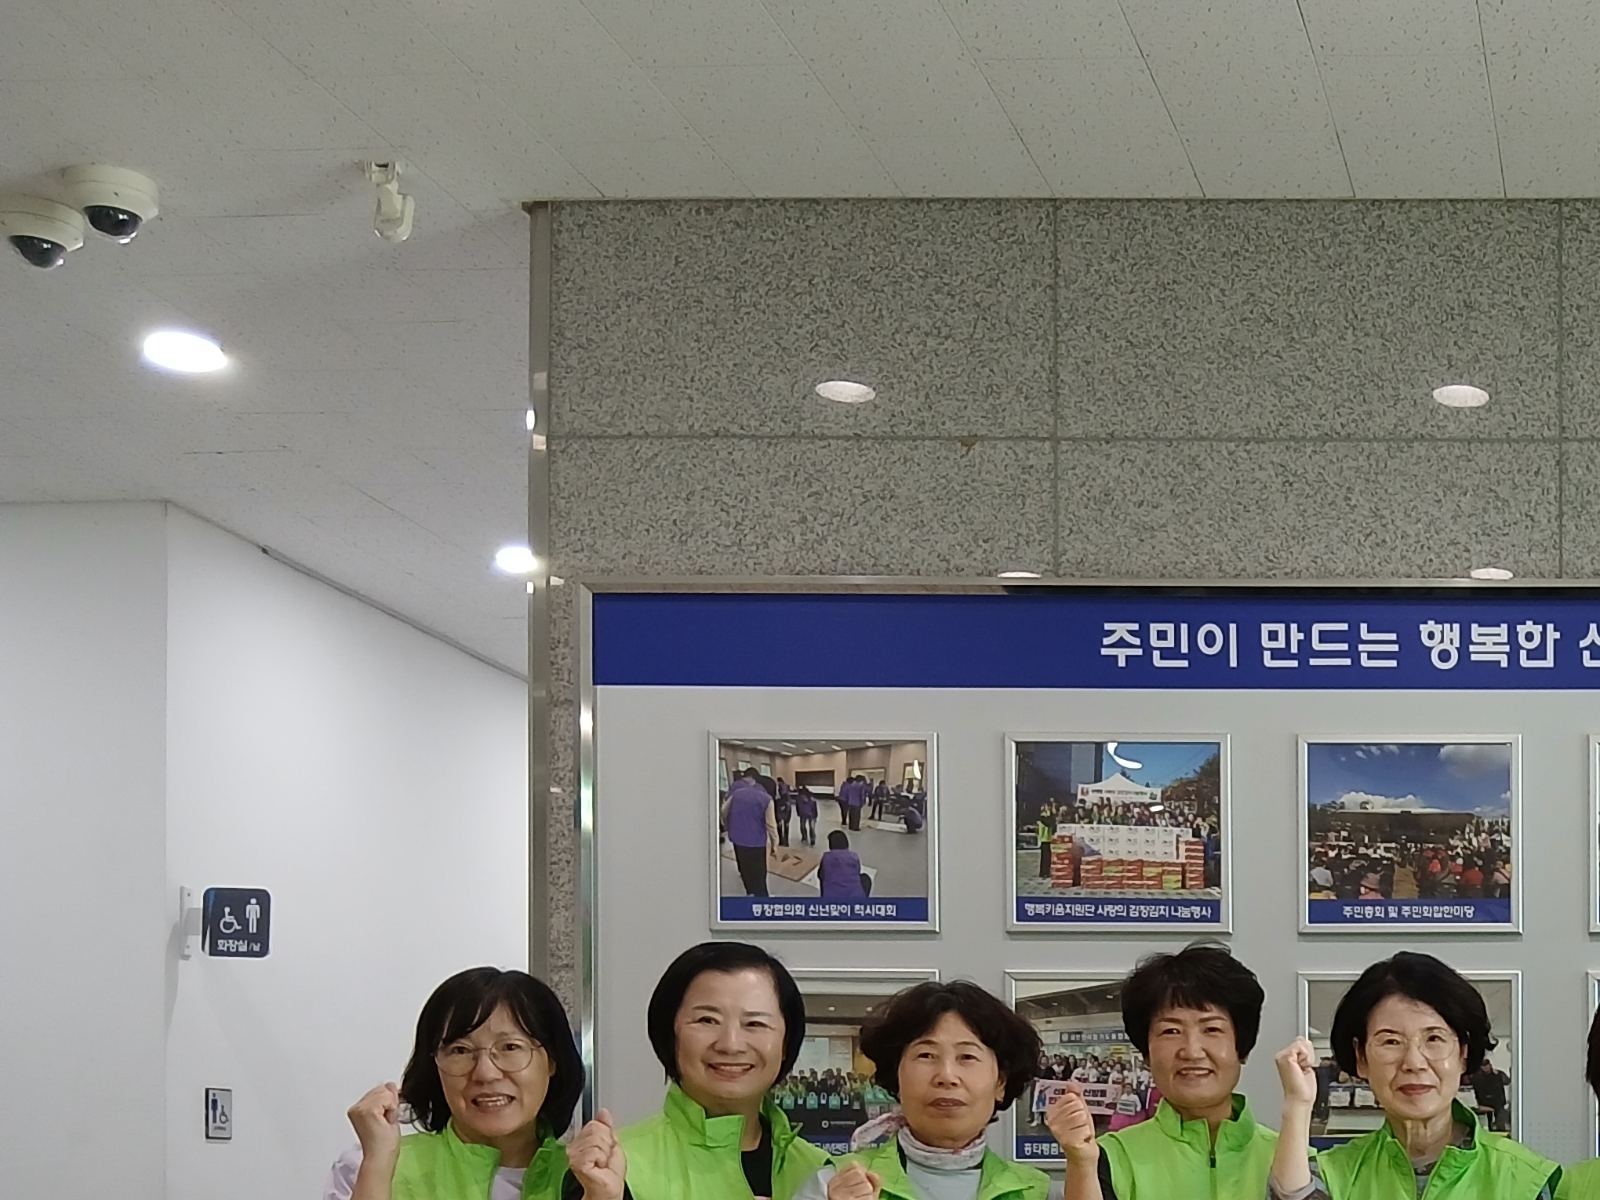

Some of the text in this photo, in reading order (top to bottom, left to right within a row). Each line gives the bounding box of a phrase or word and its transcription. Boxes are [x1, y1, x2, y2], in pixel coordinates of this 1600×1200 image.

[1099, 619, 1239, 670] 주민이
[1260, 619, 1400, 670] 만드는
[1419, 619, 1562, 671] 행복한
[808, 904, 850, 917] 신년맞이
[1097, 903, 1127, 917] 사랑의
[1129, 903, 1169, 918] 김장김치
[1171, 903, 1212, 919] 나눔행사
[1343, 906, 1385, 919] 주민총회
[1388, 906, 1398, 918] 및
